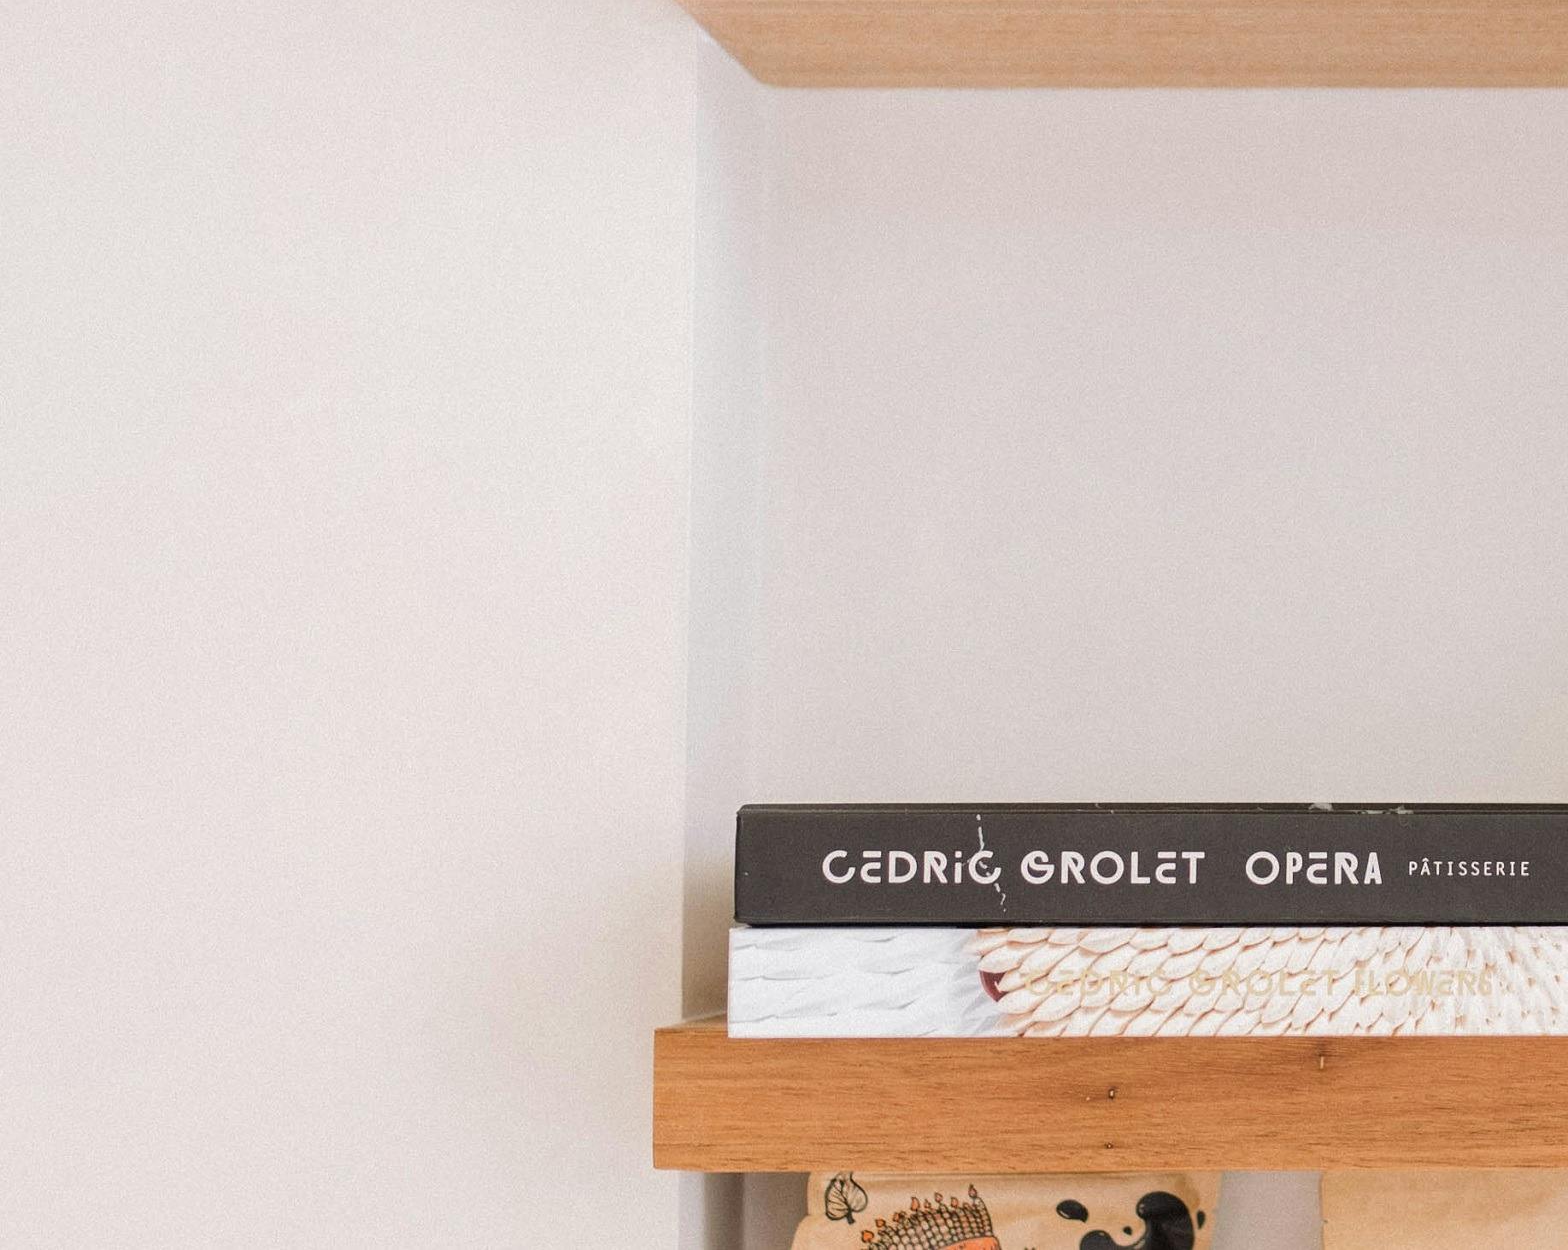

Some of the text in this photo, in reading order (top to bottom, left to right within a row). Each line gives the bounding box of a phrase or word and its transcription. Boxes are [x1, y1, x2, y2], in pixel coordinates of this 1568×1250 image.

[1020, 850, 1206, 885] GROLET
[1245, 851, 1382, 886] OPERA
[1408, 857, 1531, 877] PÂTISSERIE
[1189, 968, 1339, 998] GROLET
